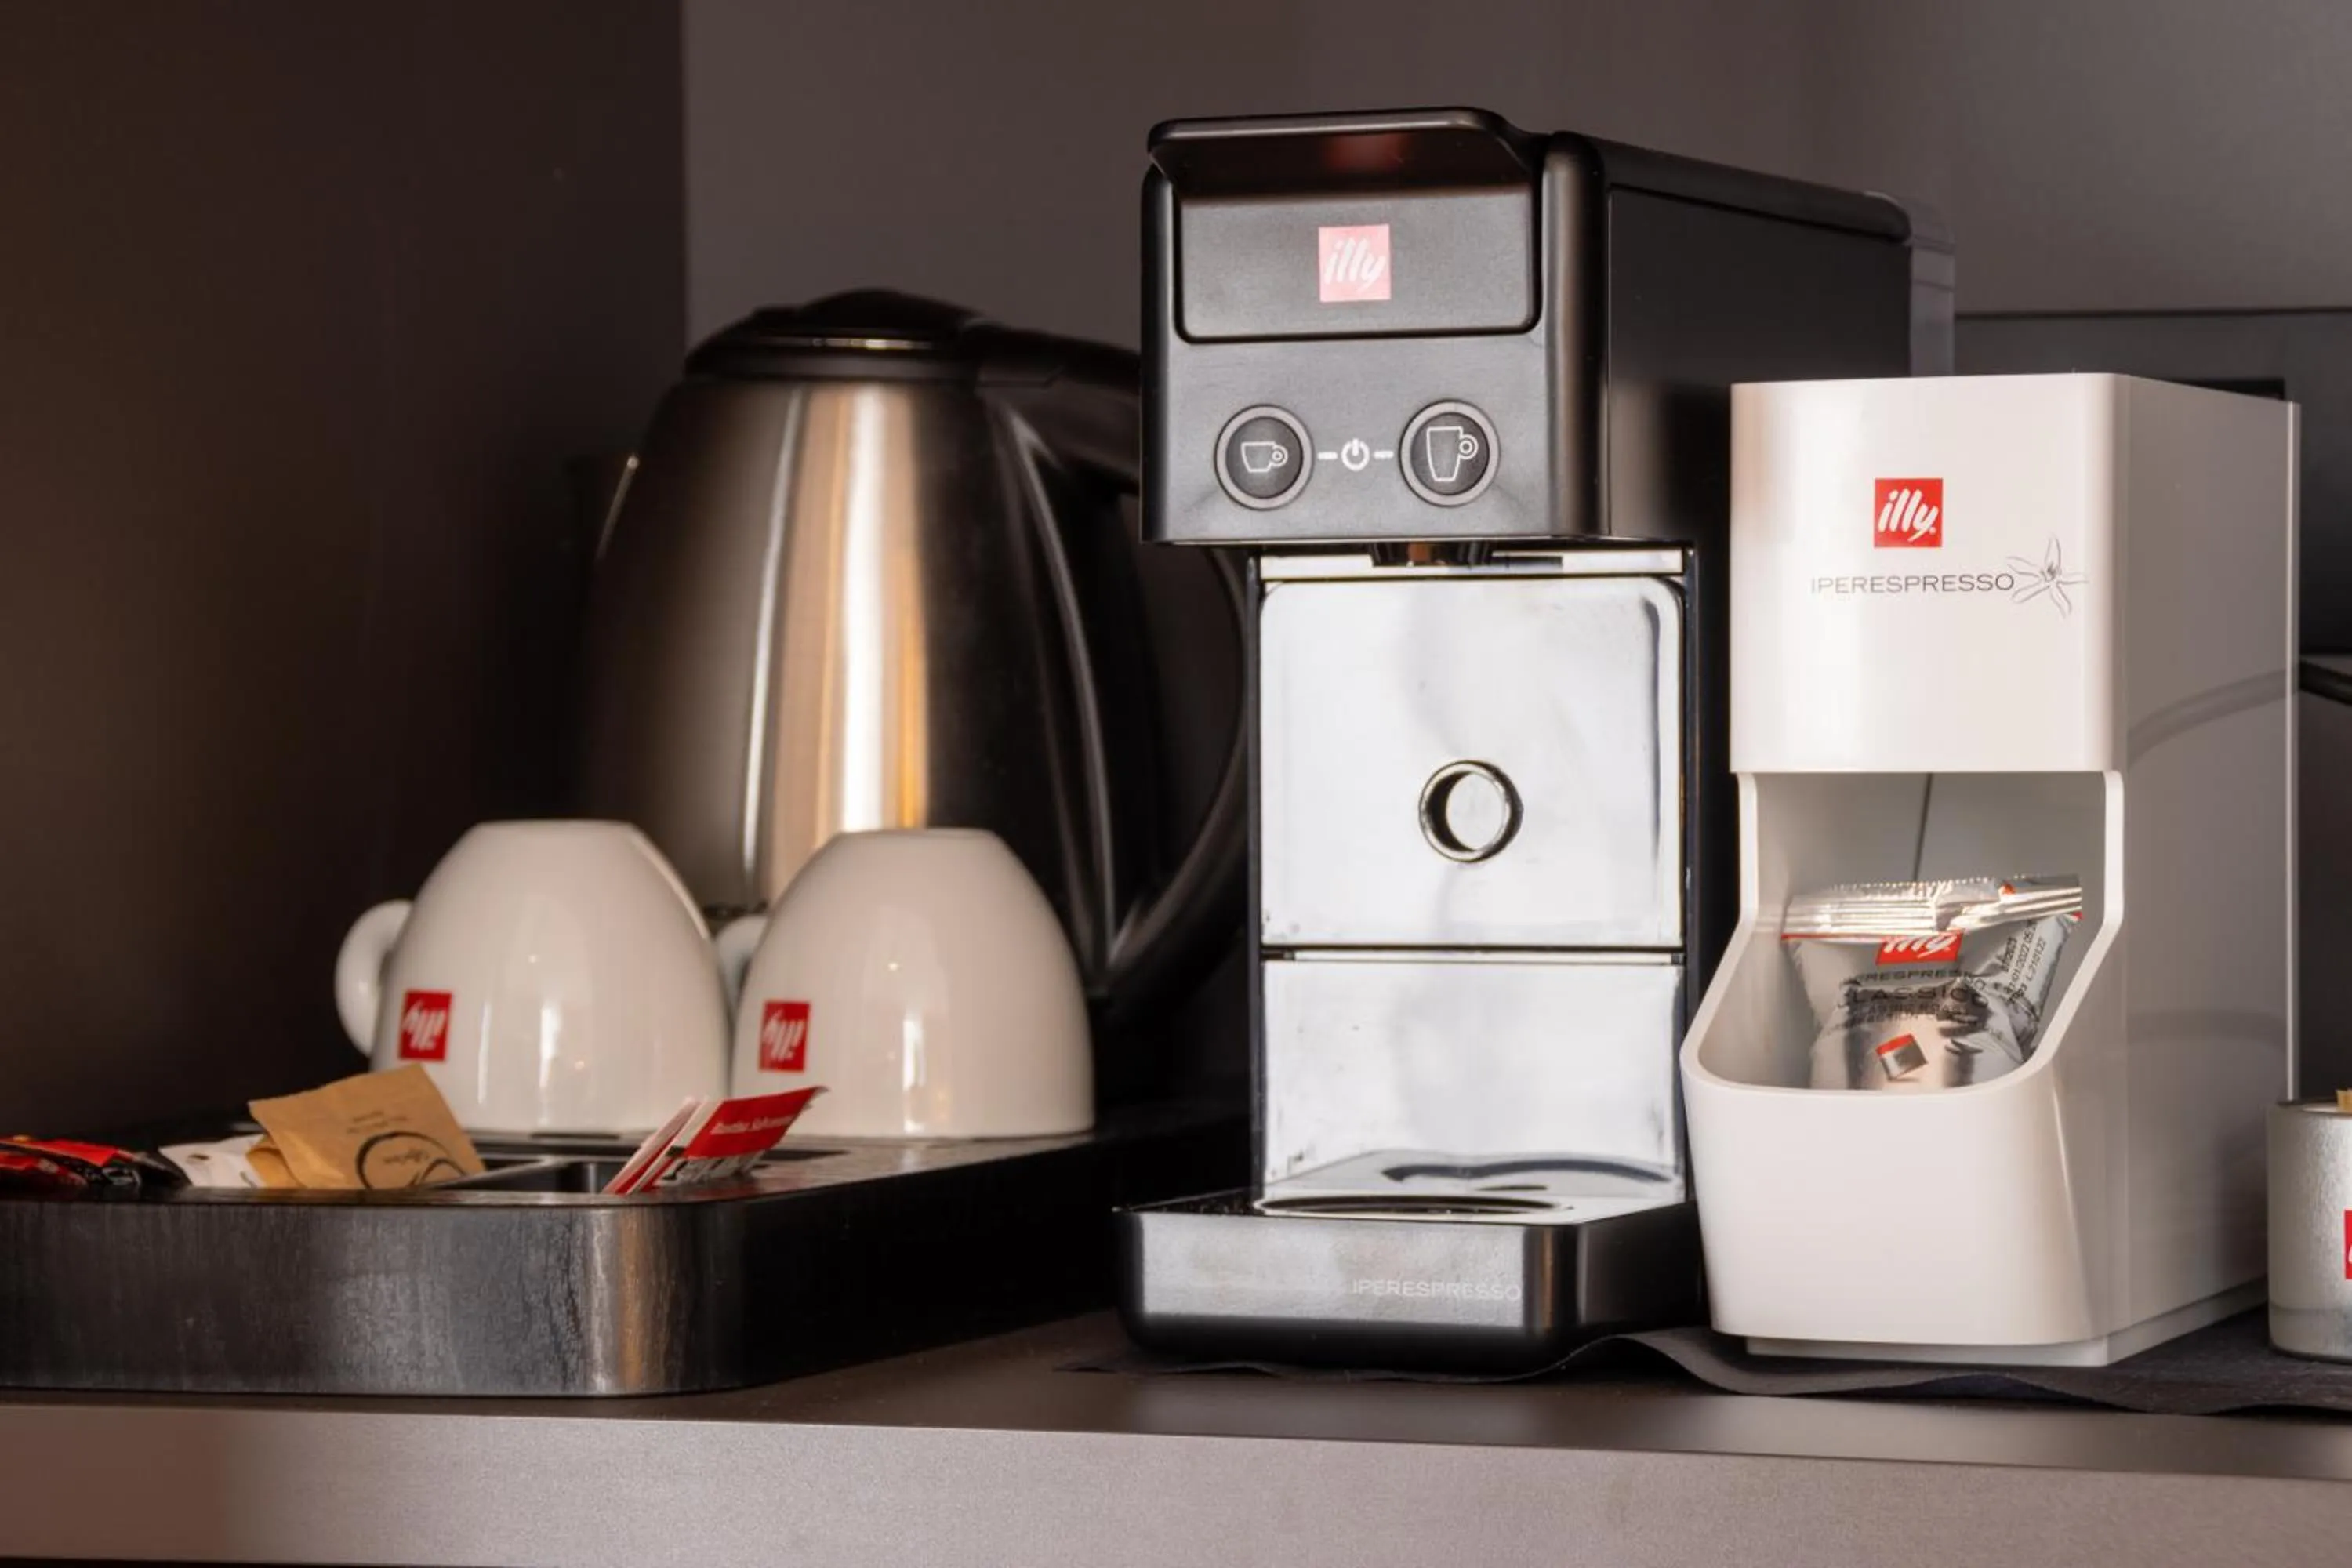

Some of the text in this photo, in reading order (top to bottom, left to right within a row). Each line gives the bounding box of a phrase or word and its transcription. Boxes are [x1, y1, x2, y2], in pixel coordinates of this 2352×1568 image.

[1324, 236, 1386, 294] illy
[1878, 489, 1940, 542] illy
[1811, 573, 2015, 594] IPERESPRESSO
[1353, 1279, 1523, 1301] IPERESPRESSO
